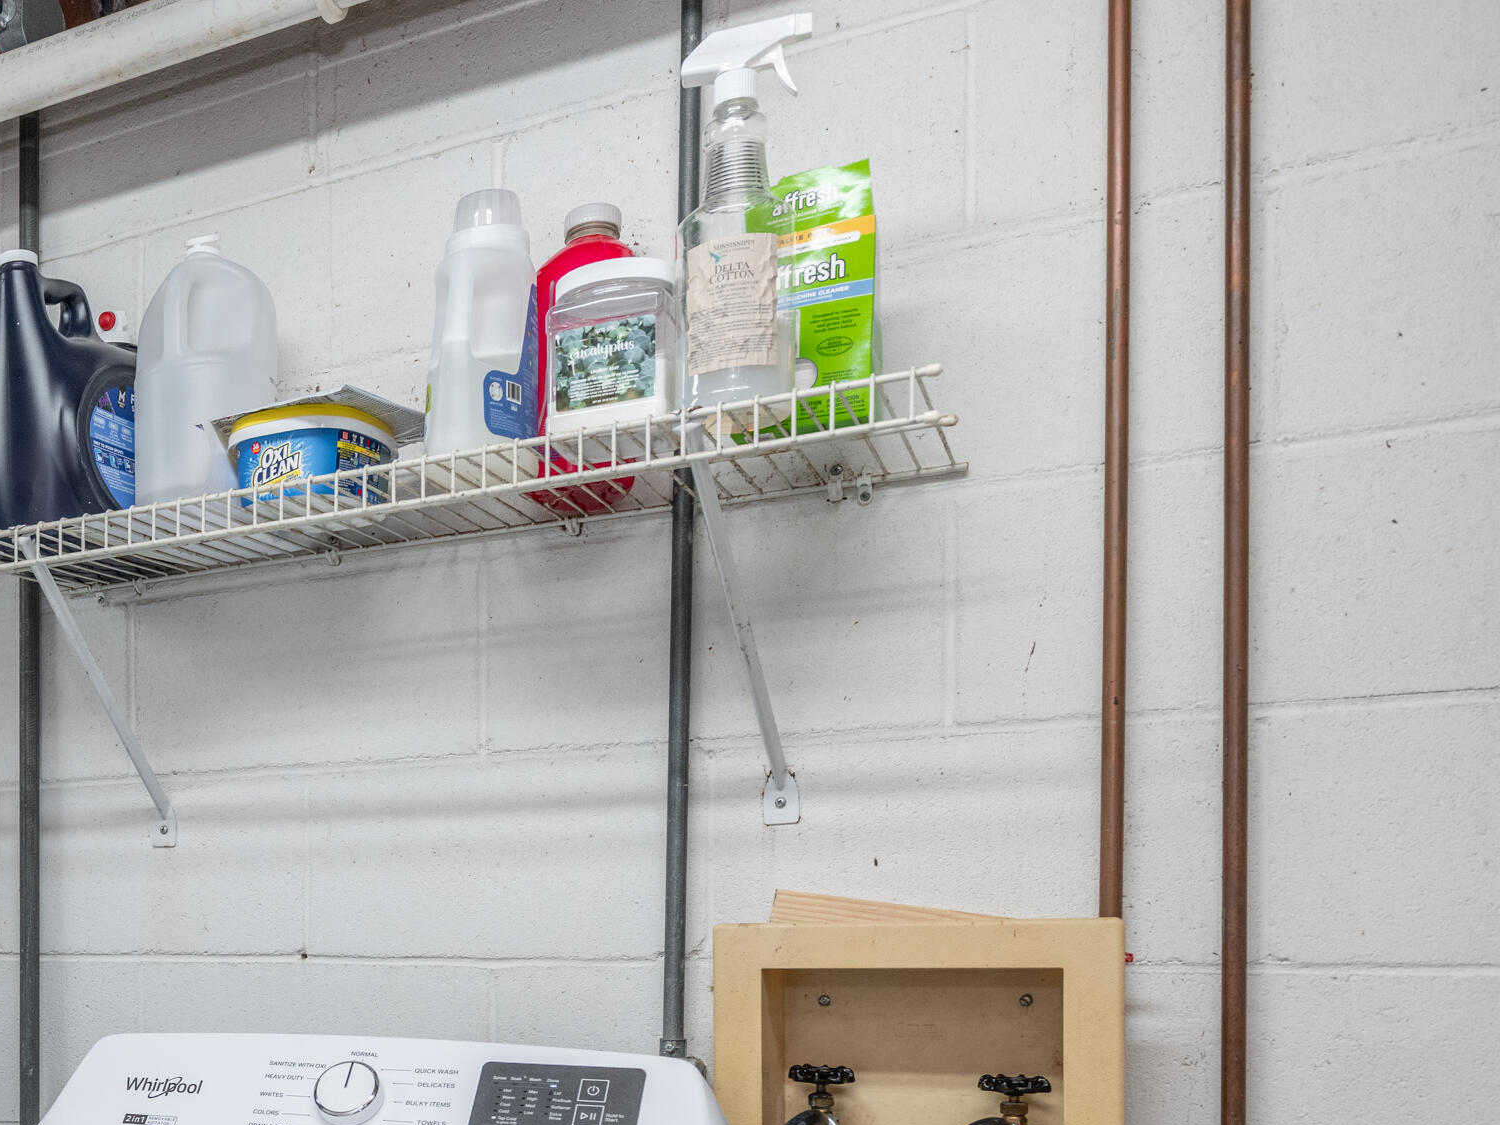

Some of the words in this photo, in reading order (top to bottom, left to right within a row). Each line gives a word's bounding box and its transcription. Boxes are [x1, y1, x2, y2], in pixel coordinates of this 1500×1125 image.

[772, 183, 839, 217] affresh
[709, 270, 755, 284] COTTON
[715, 262, 750, 274] DELTA
[777, 252, 846, 290] ffresh
[818, 285, 850, 296] CLEANER
[569, 339, 635, 359] eucalyptus
[261, 443, 289, 469] OXI
[253, 452, 300, 485] CLEAN
[126, 1077, 203, 1098] Whirlpool
[417, 1081, 456, 1089] DELICATES
[252, 1108, 280, 1116] COLORS
